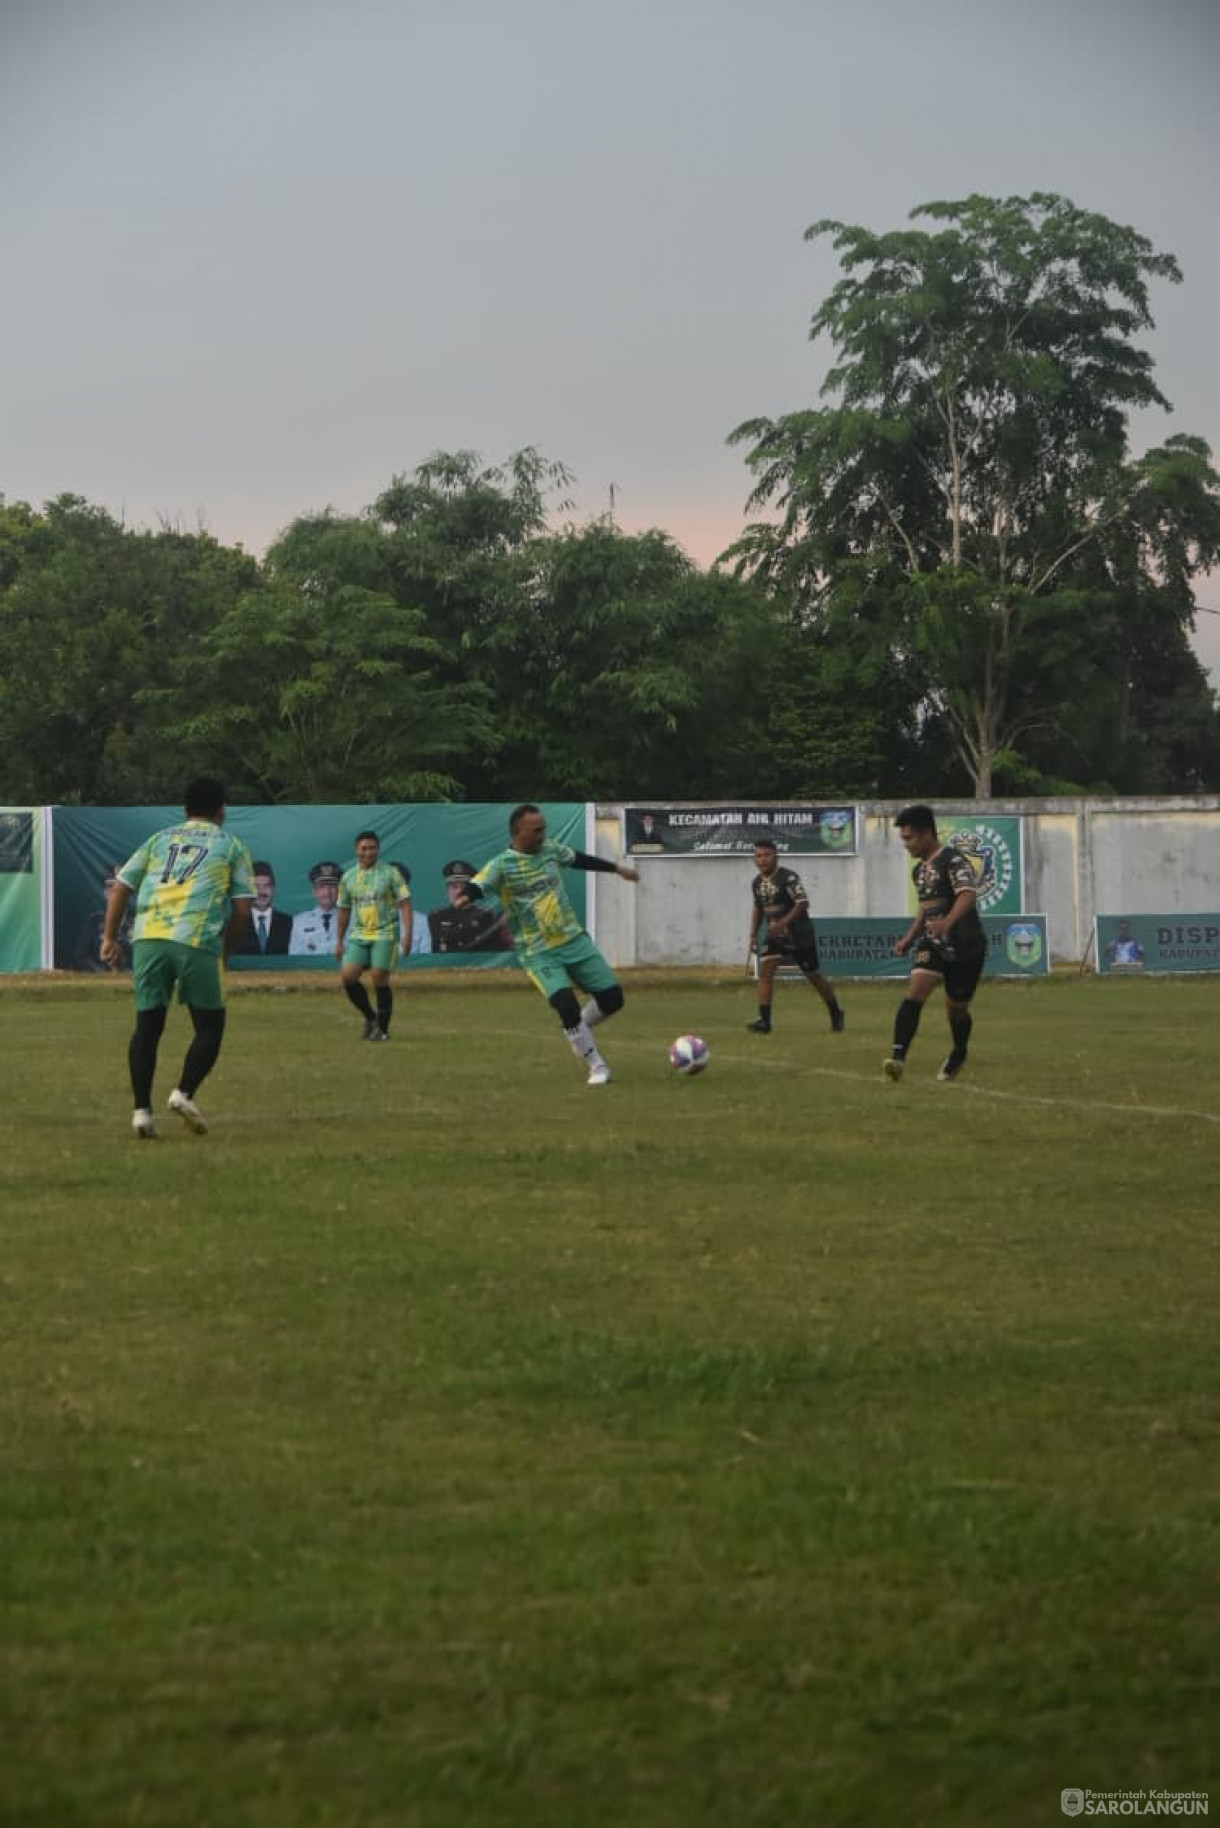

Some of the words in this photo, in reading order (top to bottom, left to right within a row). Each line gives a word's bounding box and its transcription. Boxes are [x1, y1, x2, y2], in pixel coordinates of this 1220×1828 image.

[668, 813, 743, 826] KECAMATAN
[747, 812, 769, 825] AIR
[773, 812, 813, 825] HITAM
[161, 843, 209, 885] 17
[1157, 926, 1219, 944] DISP
